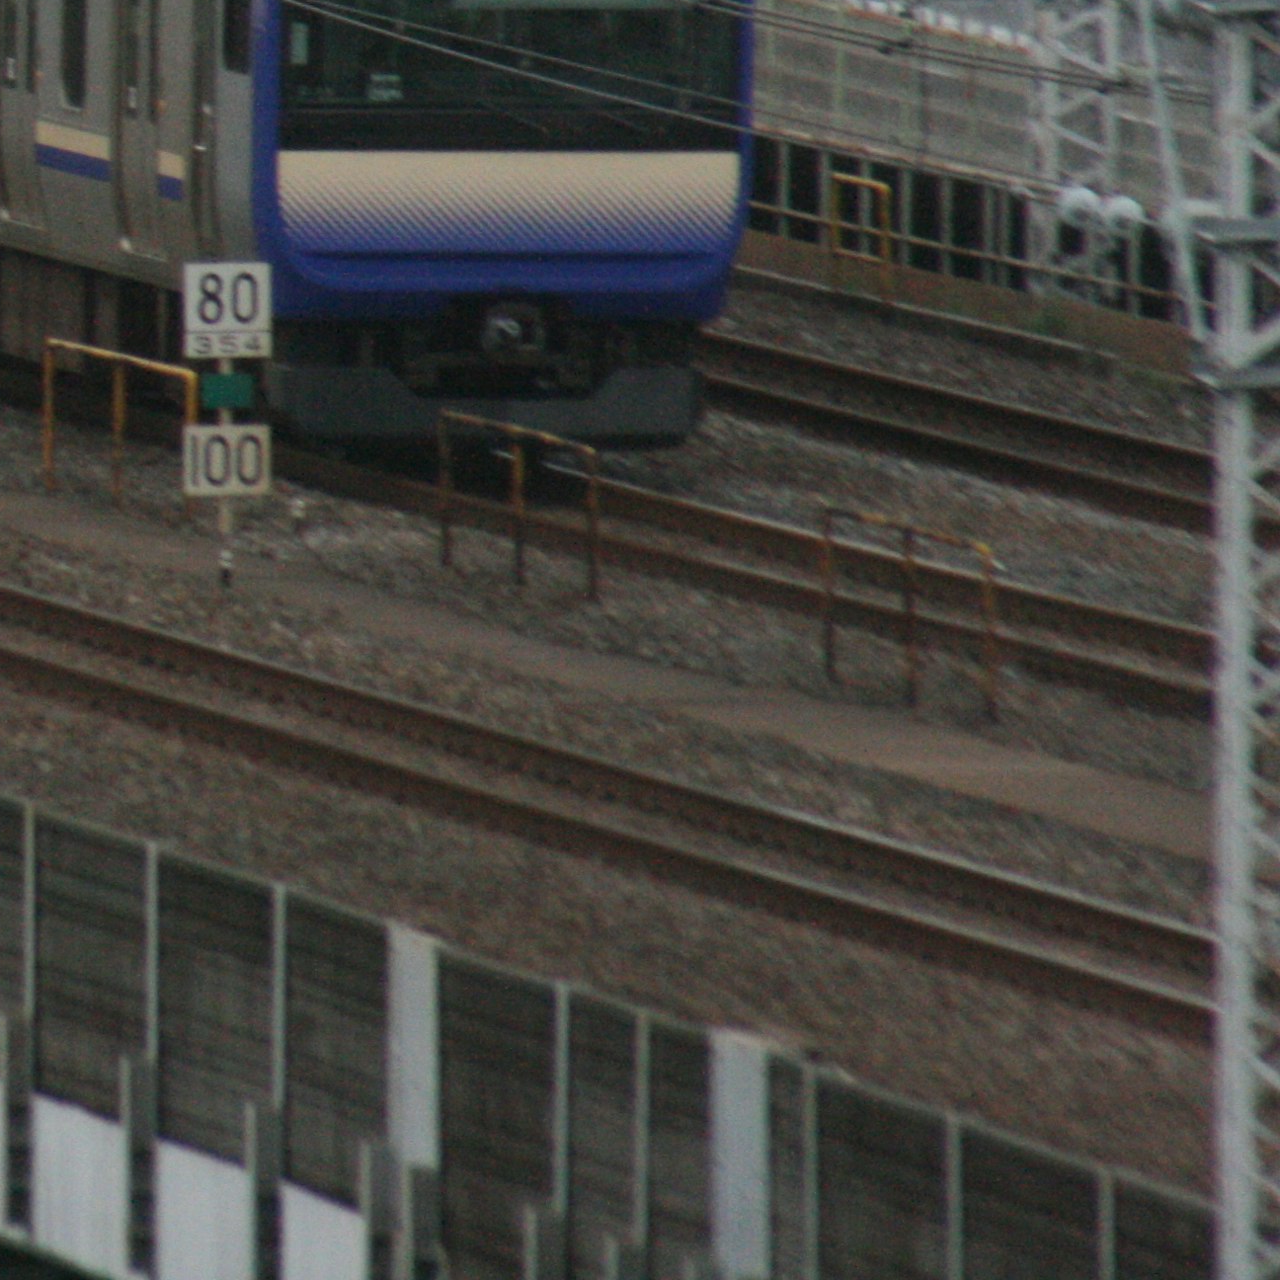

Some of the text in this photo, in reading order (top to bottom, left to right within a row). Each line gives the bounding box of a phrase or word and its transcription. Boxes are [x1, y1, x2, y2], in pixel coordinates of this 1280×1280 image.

[197, 272, 259, 325] 80
[193, 335, 262, 355] 354
[190, 434, 263, 486] 100
